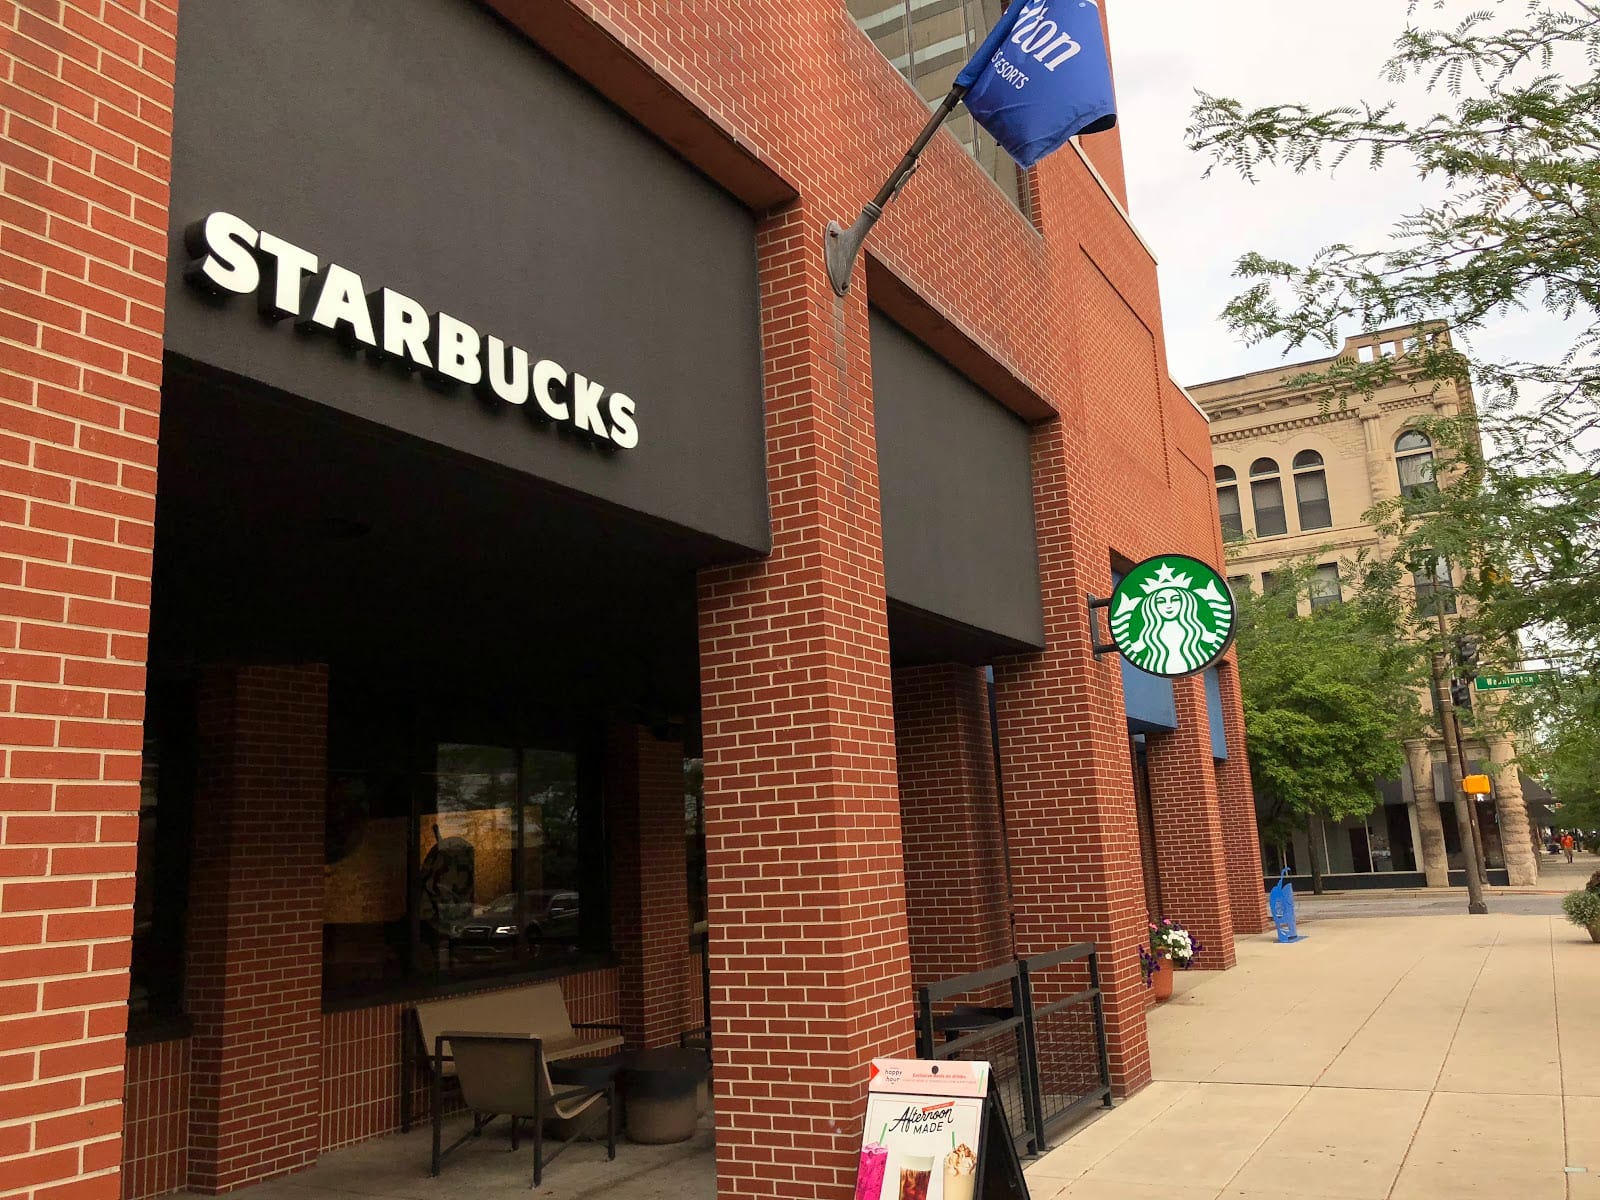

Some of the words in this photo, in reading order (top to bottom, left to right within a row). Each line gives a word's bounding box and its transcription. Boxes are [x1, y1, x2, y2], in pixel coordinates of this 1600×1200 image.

[201, 210, 639, 450] STARBUCKS
[889, 1106, 953, 1133] Afternoon
[913, 1121, 944, 1135] MADE
